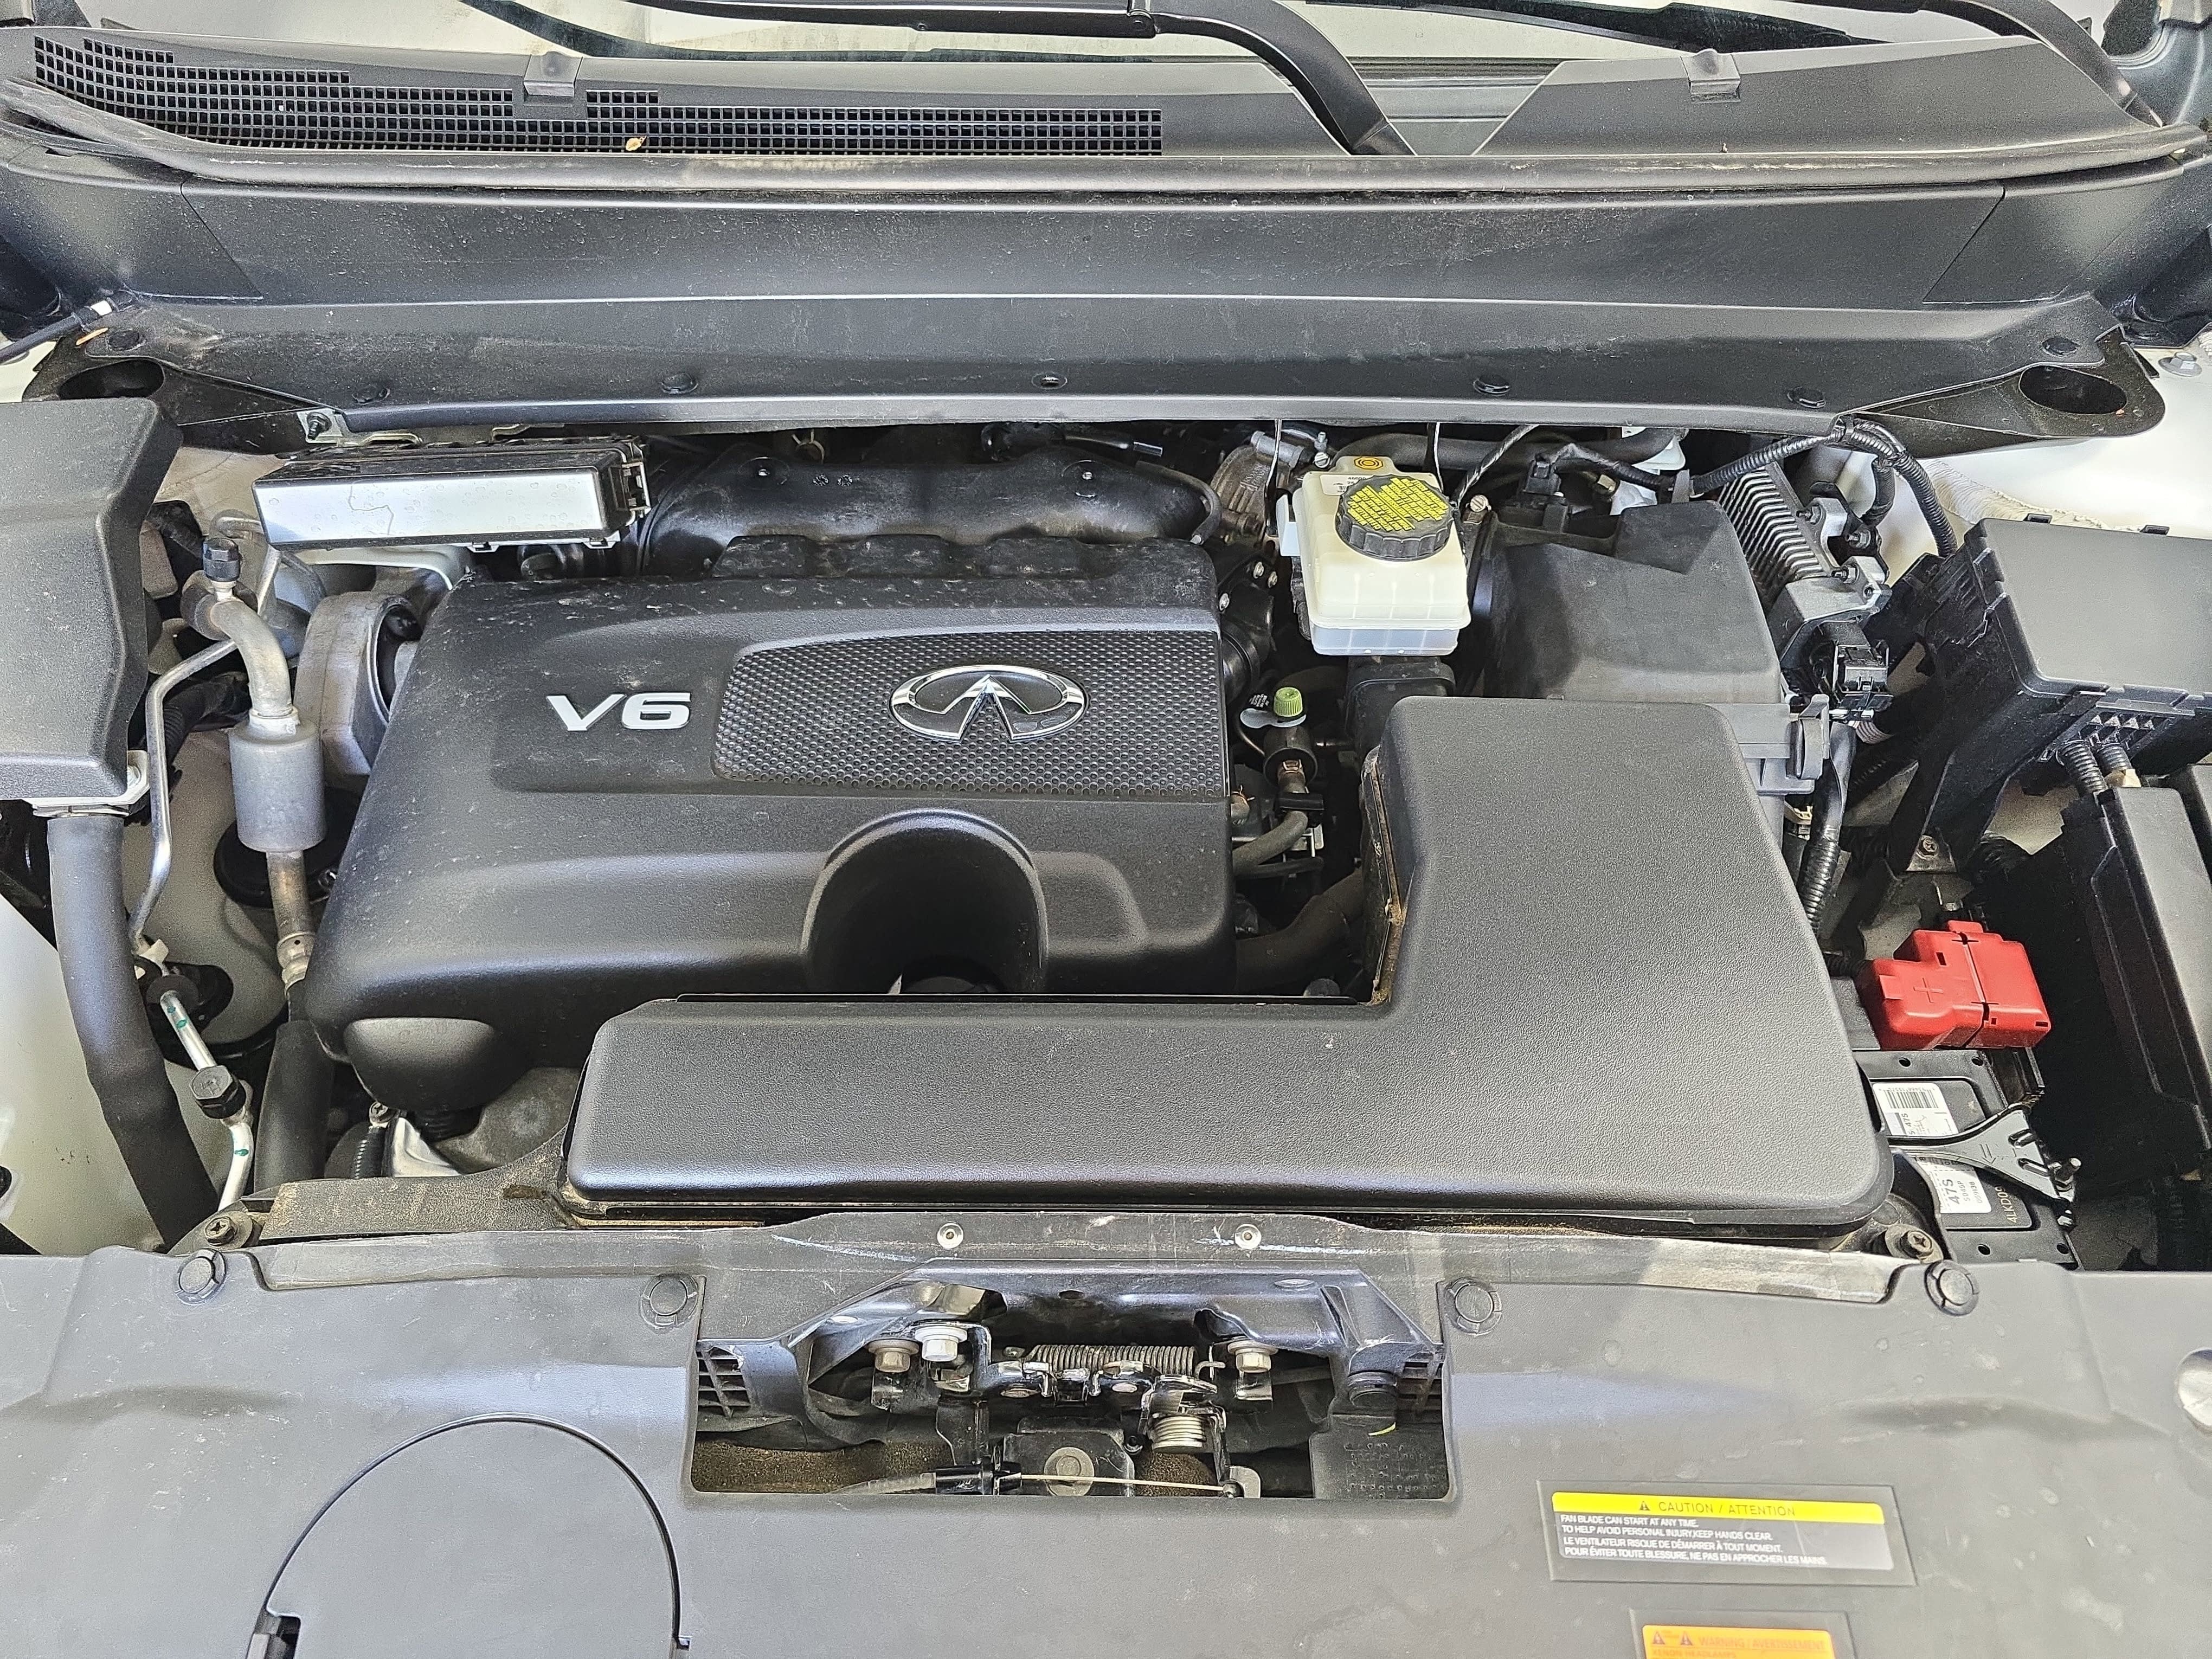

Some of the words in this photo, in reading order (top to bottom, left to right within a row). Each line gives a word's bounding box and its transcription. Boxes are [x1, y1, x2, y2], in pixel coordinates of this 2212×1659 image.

[546, 692, 692, 732] V6
[1942, 1179, 1960, 1205] 47S
[1995, 1186, 2018, 1223] 4LKD09
[1658, 1502, 1714, 1513] CAUTION
[1729, 1504, 1796, 1516] ATTENTION
[1561, 1515, 1577, 1523] FAN
[1578, 1515, 1604, 1524] BLADE
[1605, 1516, 1623, 1525] CAN
[1624, 1517, 1648, 1525] START
[1650, 1517, 1661, 1526] AT
[1562, 1525, 1573, 1533] TO
[1575, 1526, 1596, 1534] HELP
[1597, 1527, 1622, 1535] AVOID
[1622, 1527, 1665, 1536] PERSONAL
[1715, 1531, 1744, 1540] HANDS
[1564, 1536, 1575, 1545] LE
[1576, 1537, 1626, 1547] VENTILATEUR
[1627, 1539, 1657, 1548] RISQUE
[1658, 1540, 1670, 1548] DE
[1670, 1538, 1715, 1551] DÉMARRER
[1716, 1540, 1723, 1551] À
[1723, 1543, 1744, 1551] TOUT
[1565, 1547, 1590, 1556] POUR
[1590, 1546, 1617, 1557] ÉVITER
[1617, 1549, 1645, 1558] TOUTE
[1690, 1552, 1702, 1560] NE
[1702, 1552, 1719, 1561] PAS
[1720, 1553, 1733, 1561] EN
[1733, 1553, 1783, 1564] APPROCHER
[1784, 1555, 1799, 1564] LES
[1698, 1637, 1744, 1648] WARNING
[1753, 1639, 1825, 1650] AVERTISSEMENT
